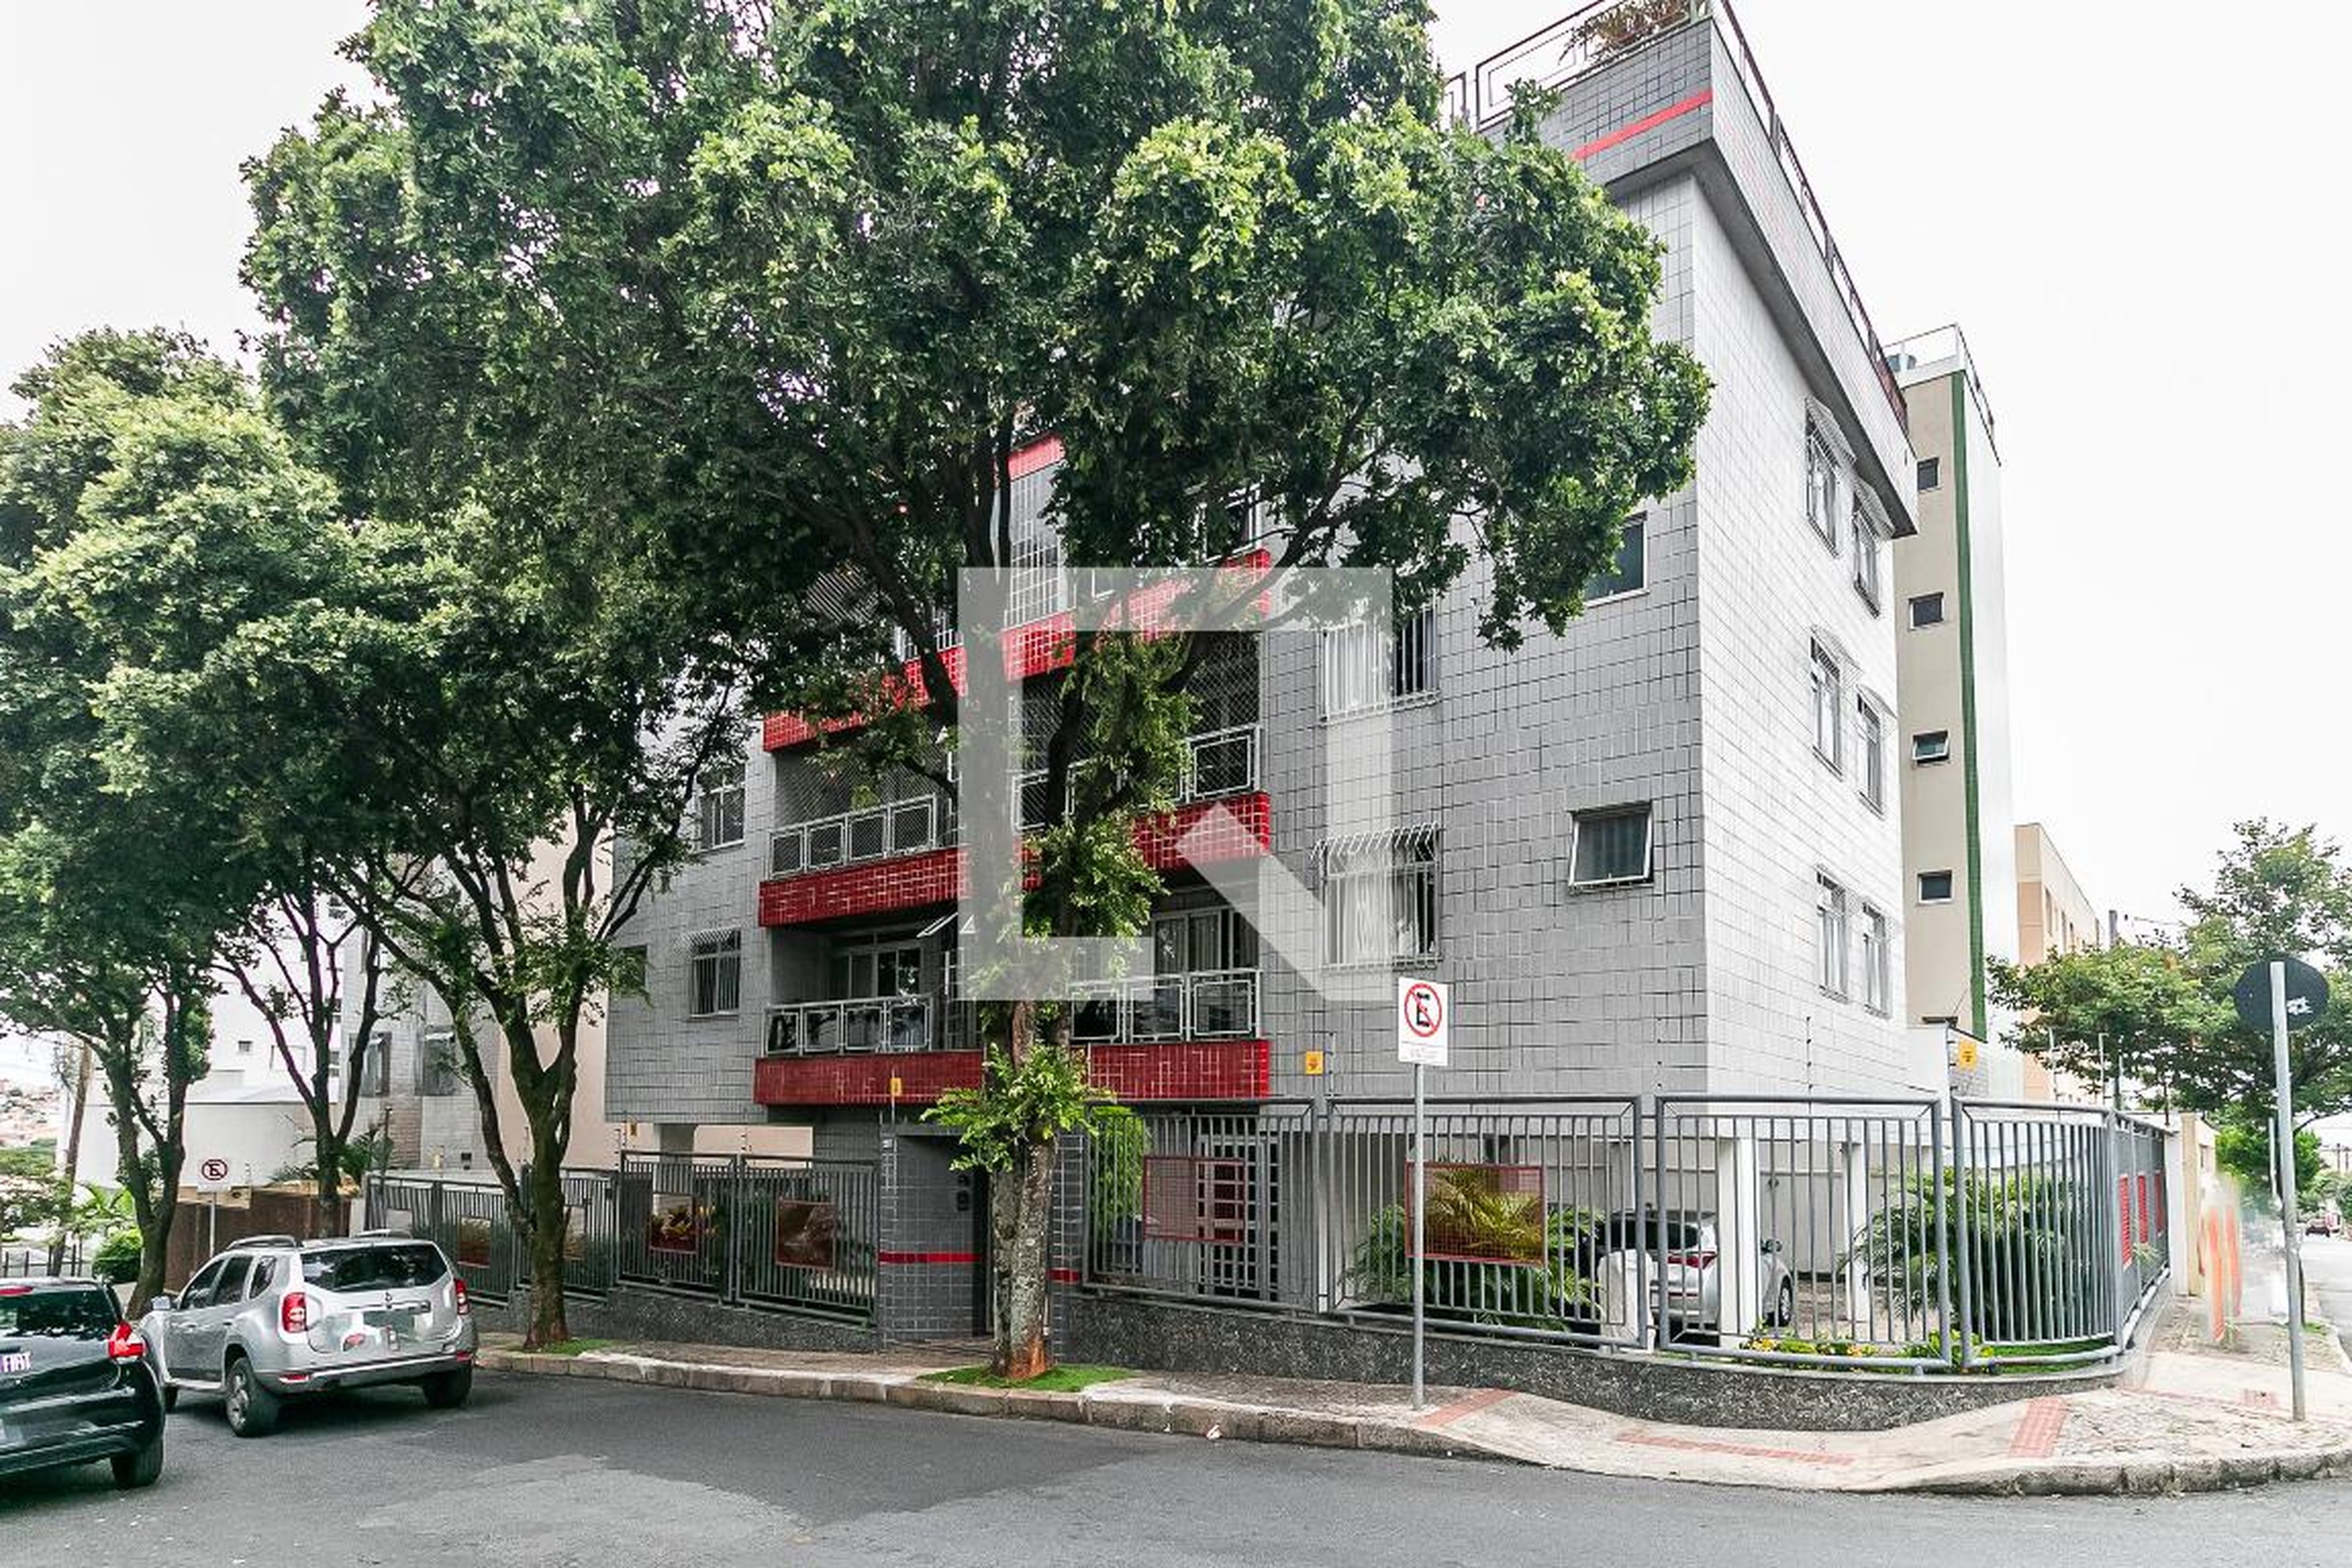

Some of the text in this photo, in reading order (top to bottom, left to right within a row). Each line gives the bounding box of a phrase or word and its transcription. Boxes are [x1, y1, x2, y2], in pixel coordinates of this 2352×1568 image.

[1416, 992, 1430, 1027] E
[209, 1163, 221, 1176] E
[3, 1351, 31, 1372] FIAT
